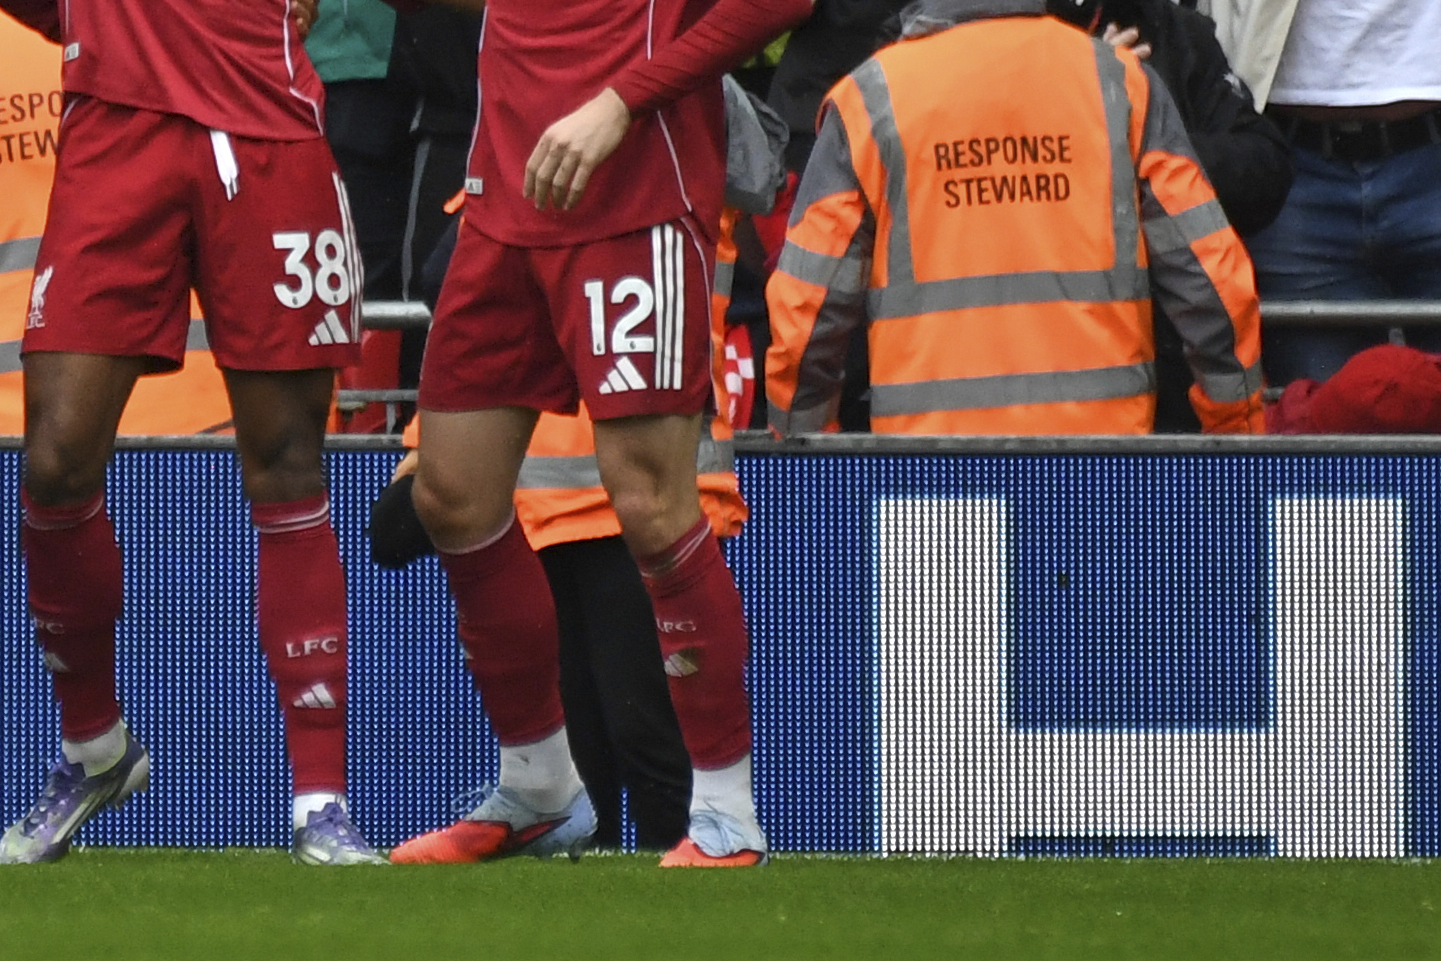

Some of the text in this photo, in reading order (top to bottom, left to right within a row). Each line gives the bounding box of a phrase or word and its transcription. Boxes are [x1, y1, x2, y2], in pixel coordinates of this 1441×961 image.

[934, 135, 1072, 172] RESPONSE
[943, 172, 1071, 209] STEWARD
[272, 228, 351, 309] 38
[584, 277, 655, 356] 12
[286, 637, 338, 658] LFC
